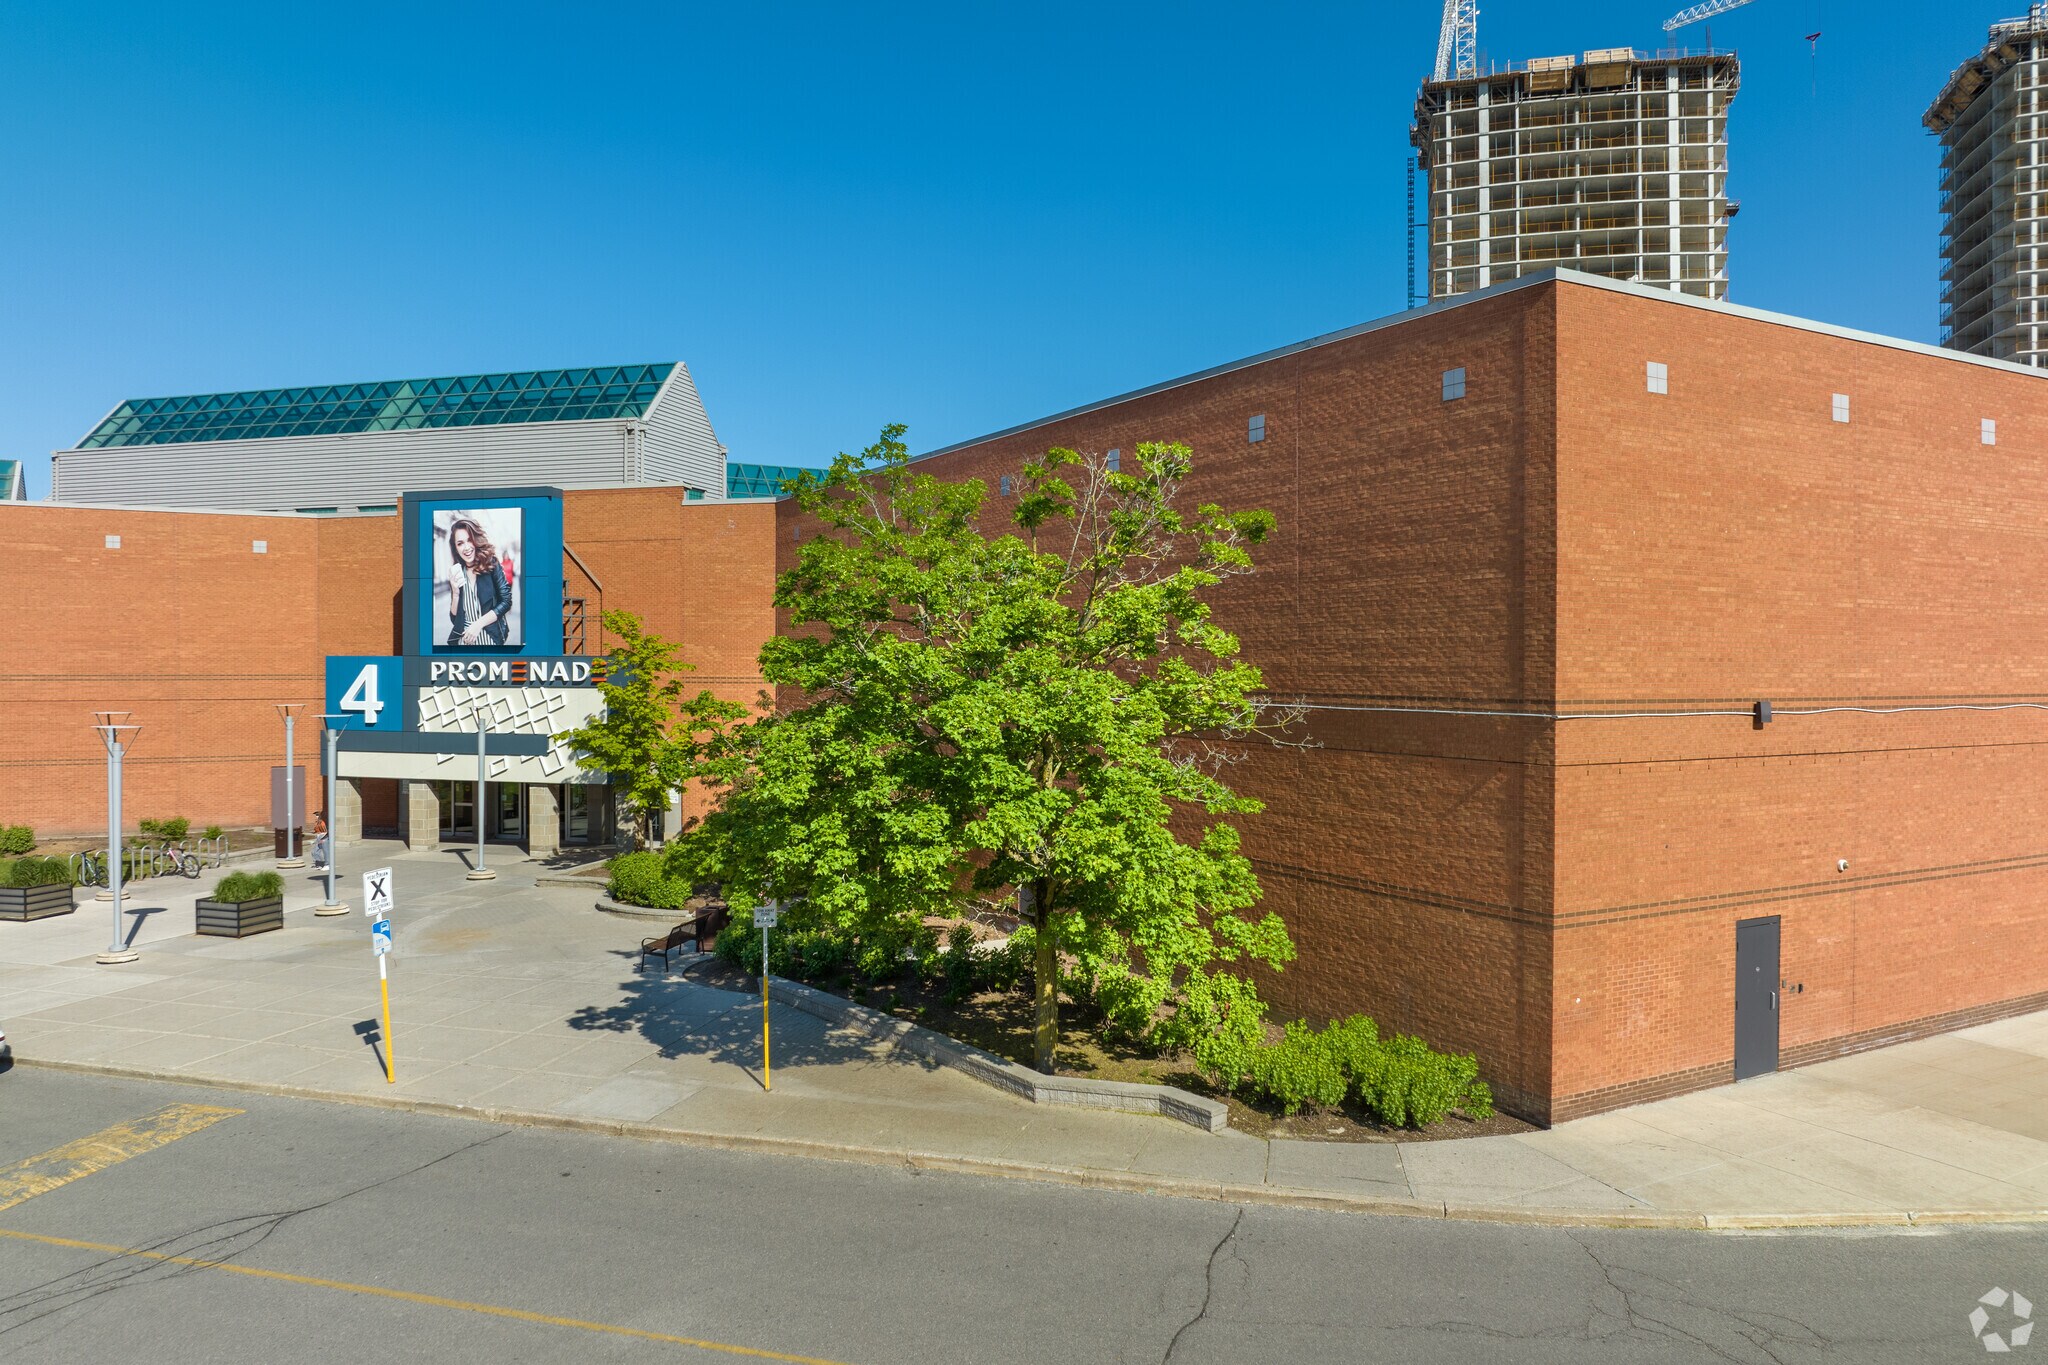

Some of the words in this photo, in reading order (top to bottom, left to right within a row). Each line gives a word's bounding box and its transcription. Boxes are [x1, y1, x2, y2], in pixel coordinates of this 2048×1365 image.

[431, 661, 607, 682] PROMENADE
[340, 664, 384, 724] 4
[652, 816, 659, 830] 4
[370, 877, 387, 901] X
